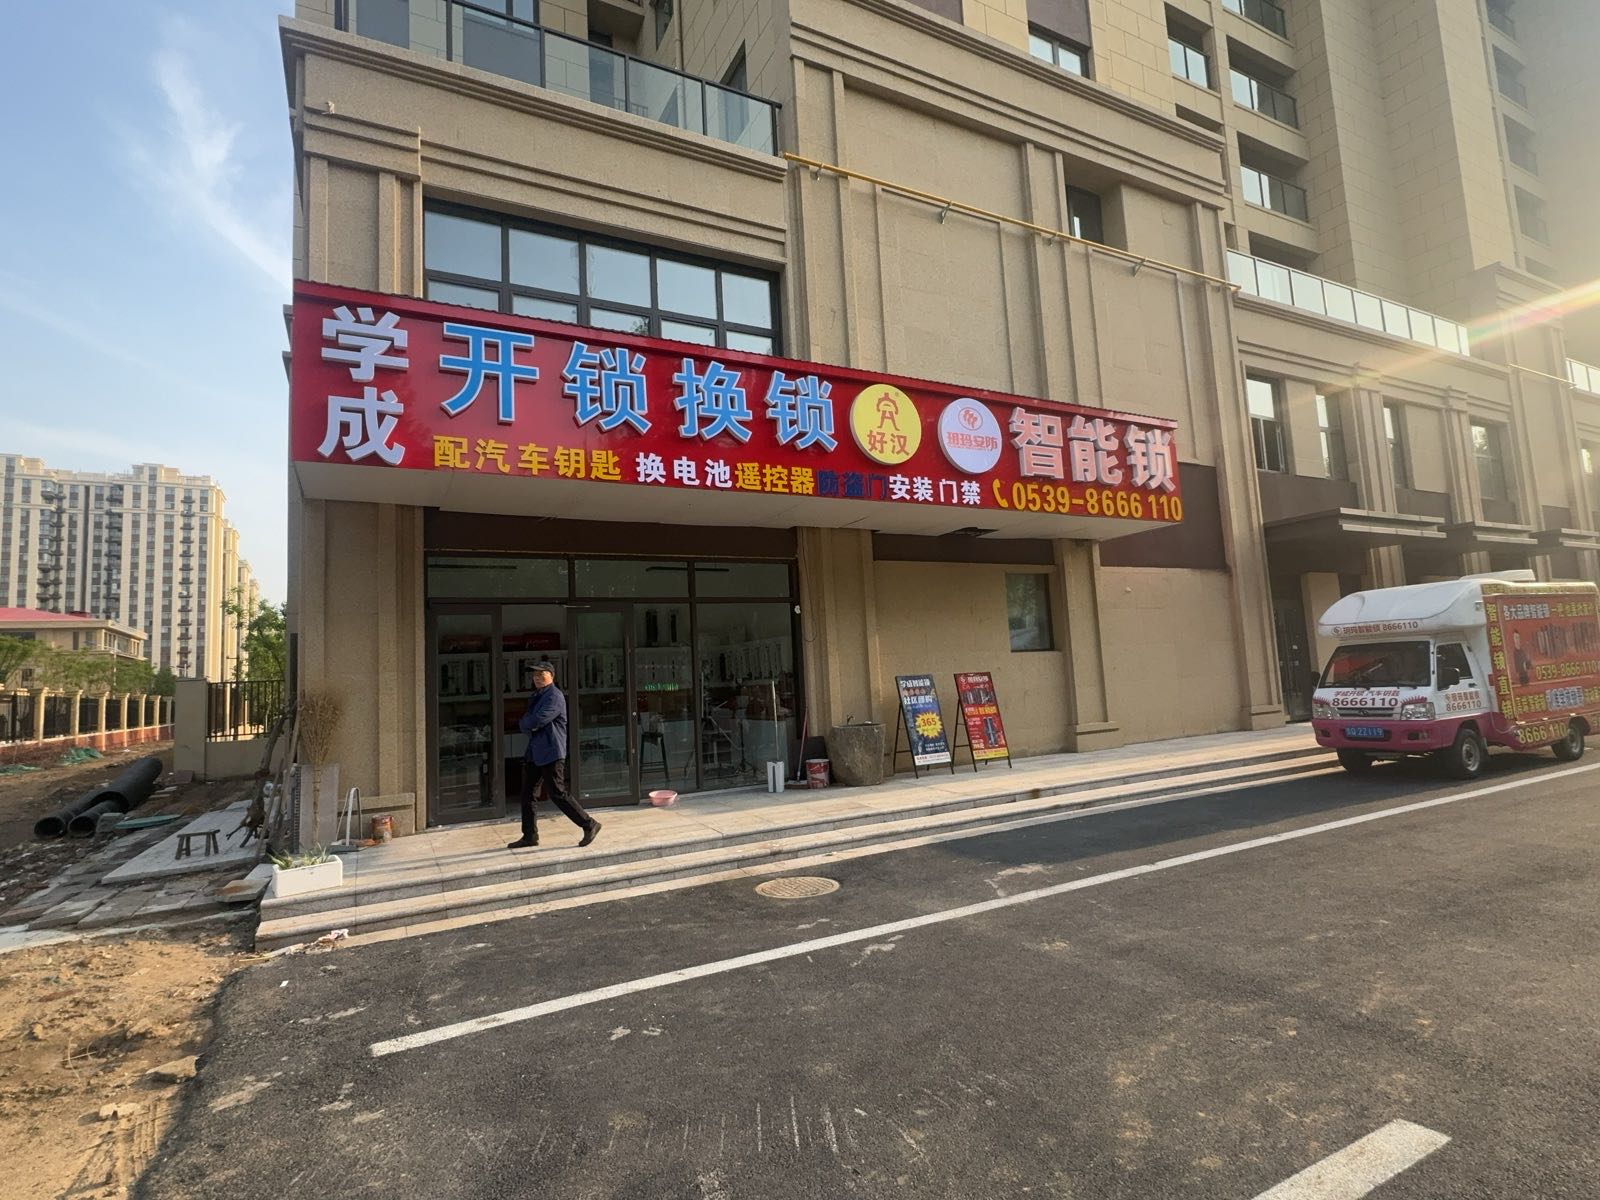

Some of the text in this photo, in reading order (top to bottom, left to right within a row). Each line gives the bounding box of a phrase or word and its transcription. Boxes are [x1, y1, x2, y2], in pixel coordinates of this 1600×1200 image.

[317, 305, 409, 465] 学成
[438, 322, 838, 452] 开锁换锁
[866, 429, 910, 456] 好汉
[1009, 407, 1176, 492] 智能锁
[433, 435, 621, 481] 配汽车钥匙
[635, 452, 733, 488] 换电池
[735, 463, 815, 495] 遥控器
[1382, 621, 1418, 631] 8666110
[1332, 697, 1399, 707] 8666110
[1446, 700, 1481, 711] 8666110
[920, 718, 937, 726] 365
